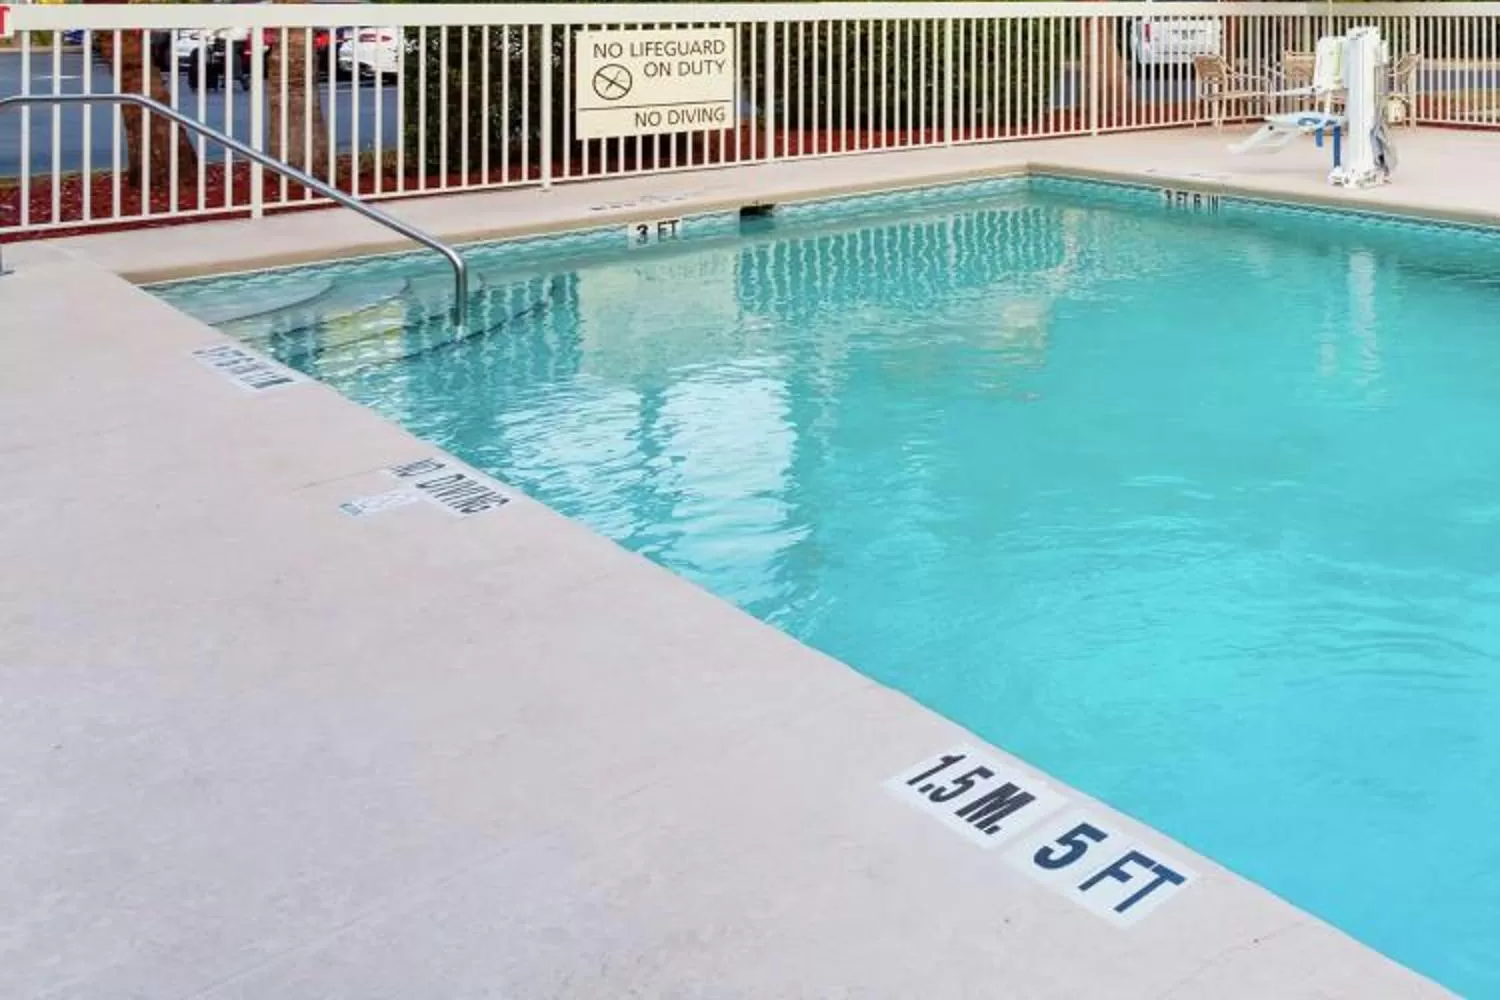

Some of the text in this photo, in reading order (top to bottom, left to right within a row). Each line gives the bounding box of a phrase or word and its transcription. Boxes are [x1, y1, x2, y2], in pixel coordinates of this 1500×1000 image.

[593, 40, 726, 58] NO LIFEGUARD
[643, 60, 726, 77] ON DUTY
[635, 107, 726, 127] NO DIVING
[657, 219, 680, 237] FT
[906, 754, 1187, 914] 1.5 M. 5 FT
